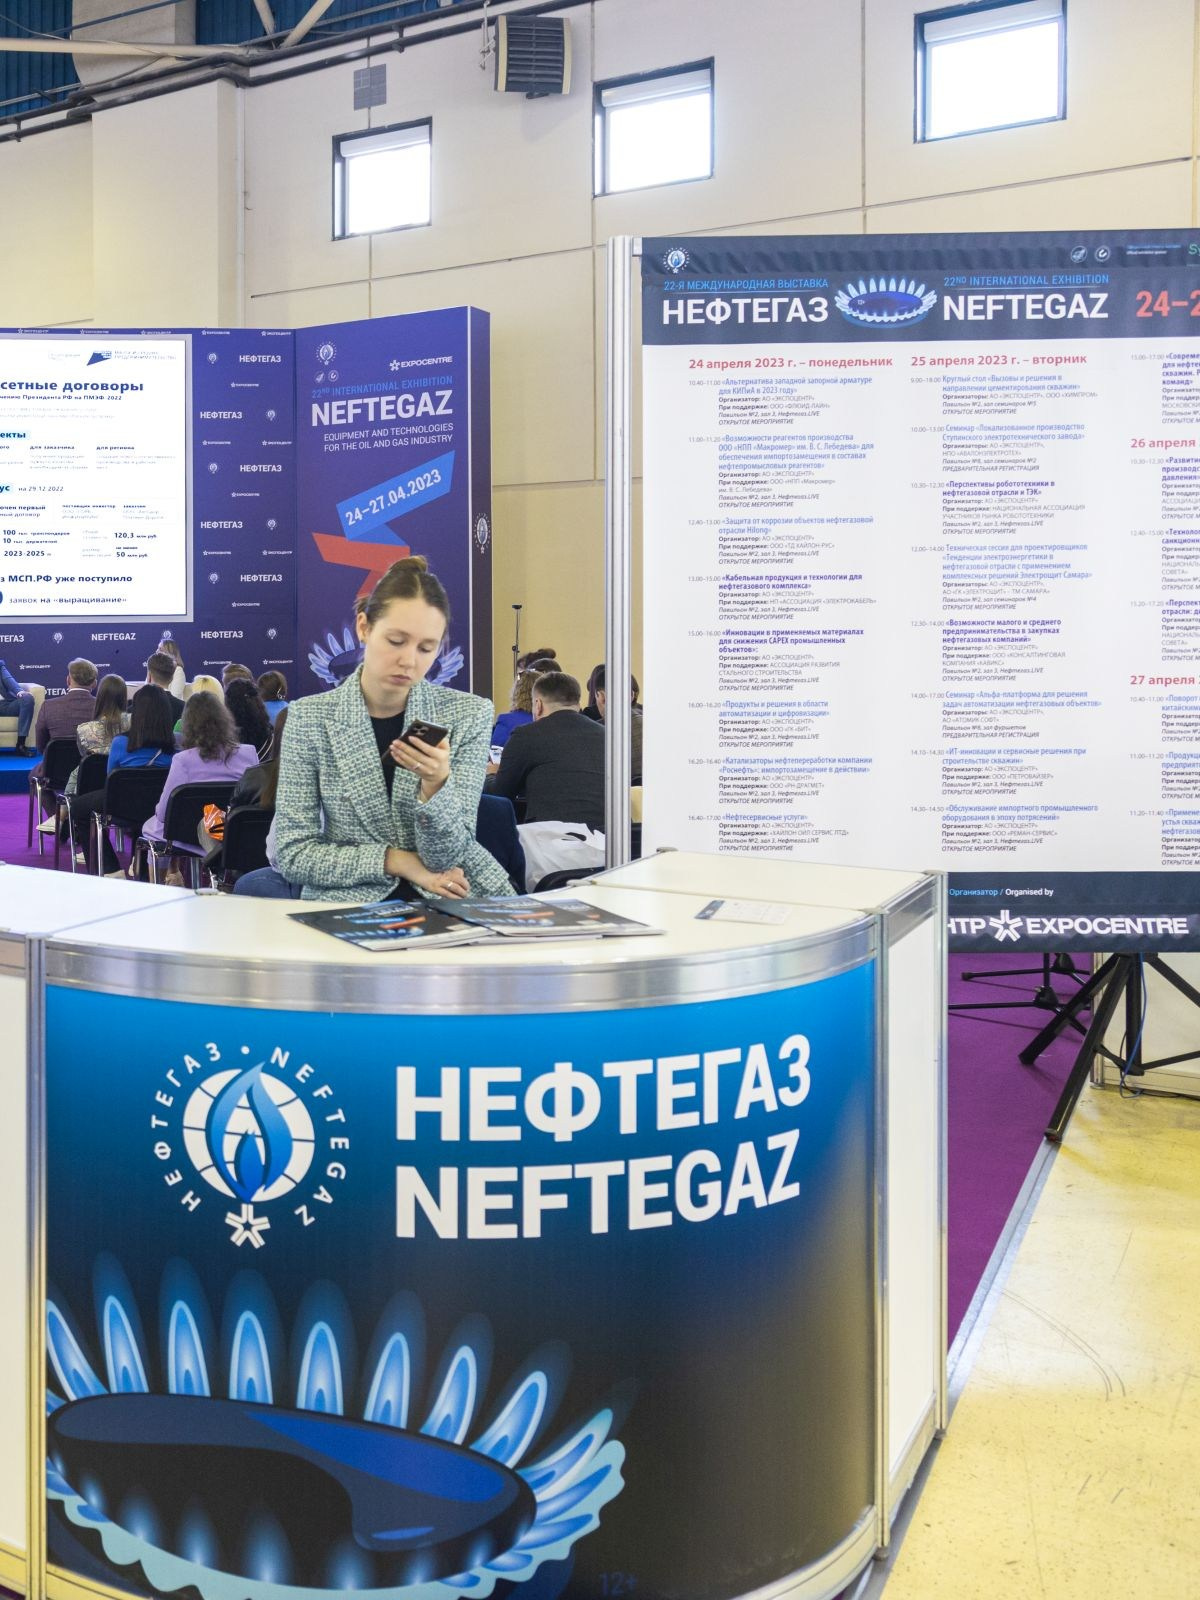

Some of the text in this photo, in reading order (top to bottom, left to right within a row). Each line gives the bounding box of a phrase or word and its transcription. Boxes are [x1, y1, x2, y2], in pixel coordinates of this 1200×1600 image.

[664, 278, 829, 292] 22-Я МЕЖДУНАРОДНАЯ ВЫСТАВКА
[944, 274, 1109, 287] 22ND INTERNATIONAL EXHIBITION
[662, 297, 829, 325] НЕФТЕГАЗ
[943, 293, 1109, 321] NEFTEGAZ
[239, 354, 282, 363] НЕФТЕГАЗ
[400, 355, 453, 368] EXPOCENTRE
[688, 359, 704, 369] 24
[706, 360, 752, 371] апреля
[754, 358, 785, 368] 2023
[808, 358, 893, 370] понедельник
[911, 356, 926, 366] 25
[929, 357, 975, 368] апреля
[978, 355, 1008, 366] 2023
[1032, 354, 1087, 366] вторник
[62, 381, 144, 394] договоры
[332, 381, 399, 396] INTERNATIONAL
[401, 375, 453, 389] EXHIBITION
[311, 389, 453, 427] NEFTEGAZ
[200, 411, 243, 420] НЕФТЕГАЗ
[324, 423, 454, 442] EQUIPMENT AND TECHNOLOGIES
[324, 434, 453, 452] FOR THE OIL AND GAS INDUSTRY
[1130, 438, 1196, 451] 26 апреля
[240, 464, 282, 473] НЕФТЕГАЗ
[946, 480, 995, 490] «Перспективы
[996, 480, 1049, 489] робототехники
[345, 469, 442, 526] 24–27.04.2023
[942, 488, 990, 497] нефтегазовой
[991, 489, 1019, 497] отрасли
[200, 520, 243, 529] НЕФТЕГАЗ
[8, 575, 53, 584] МСП.РФ
[55, 576, 76, 584] уже
[78, 576, 133, 584] поступило
[240, 573, 283, 583] НЕФТЕГАЗ
[53, 597, 127, 605] «выращивание»
[91, 632, 136, 641] NEFTEGAZ
[201, 631, 244, 639] НЕФТЕГАЗ
[1130, 675, 1195, 688] 27 апреля
[949, 888, 999, 897] Организатор
[1005, 888, 1054, 897] Organised by
[1026, 917, 1190, 935] EXPOCENTRE
[396, 1034, 812, 1142] НЕФТЕГАЗ
[396, 1128, 800, 1239] NEFTEGAZ
